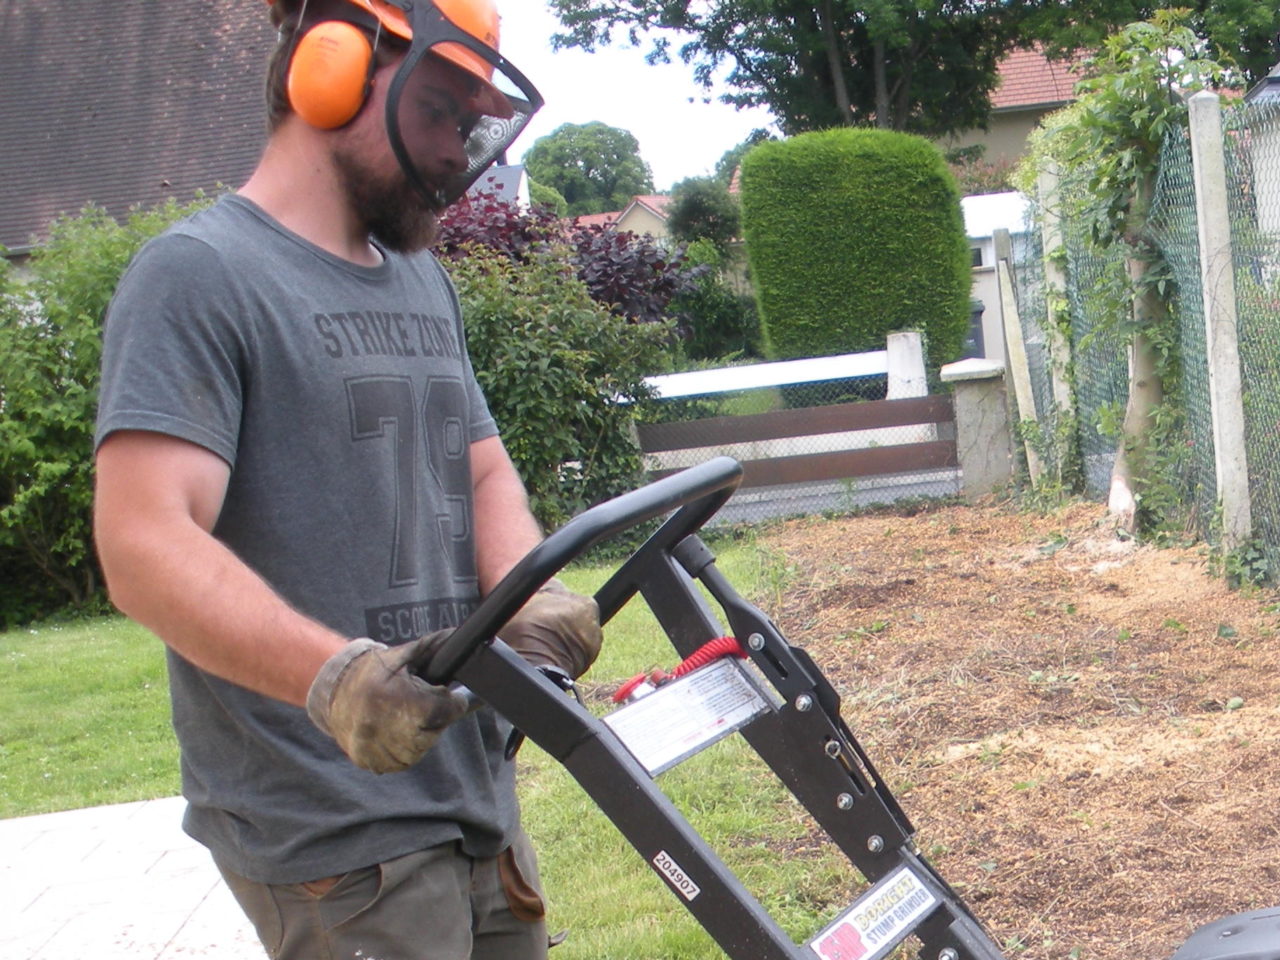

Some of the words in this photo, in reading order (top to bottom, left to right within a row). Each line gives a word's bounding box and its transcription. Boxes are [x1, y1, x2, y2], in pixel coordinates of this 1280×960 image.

[314, 311, 416, 358] STRIKE
[344, 375, 478, 588] 79
[656, 854, 696, 895] 204907
[866, 914, 896, 944] STUMP
[893, 889, 929, 921] GRINDER
